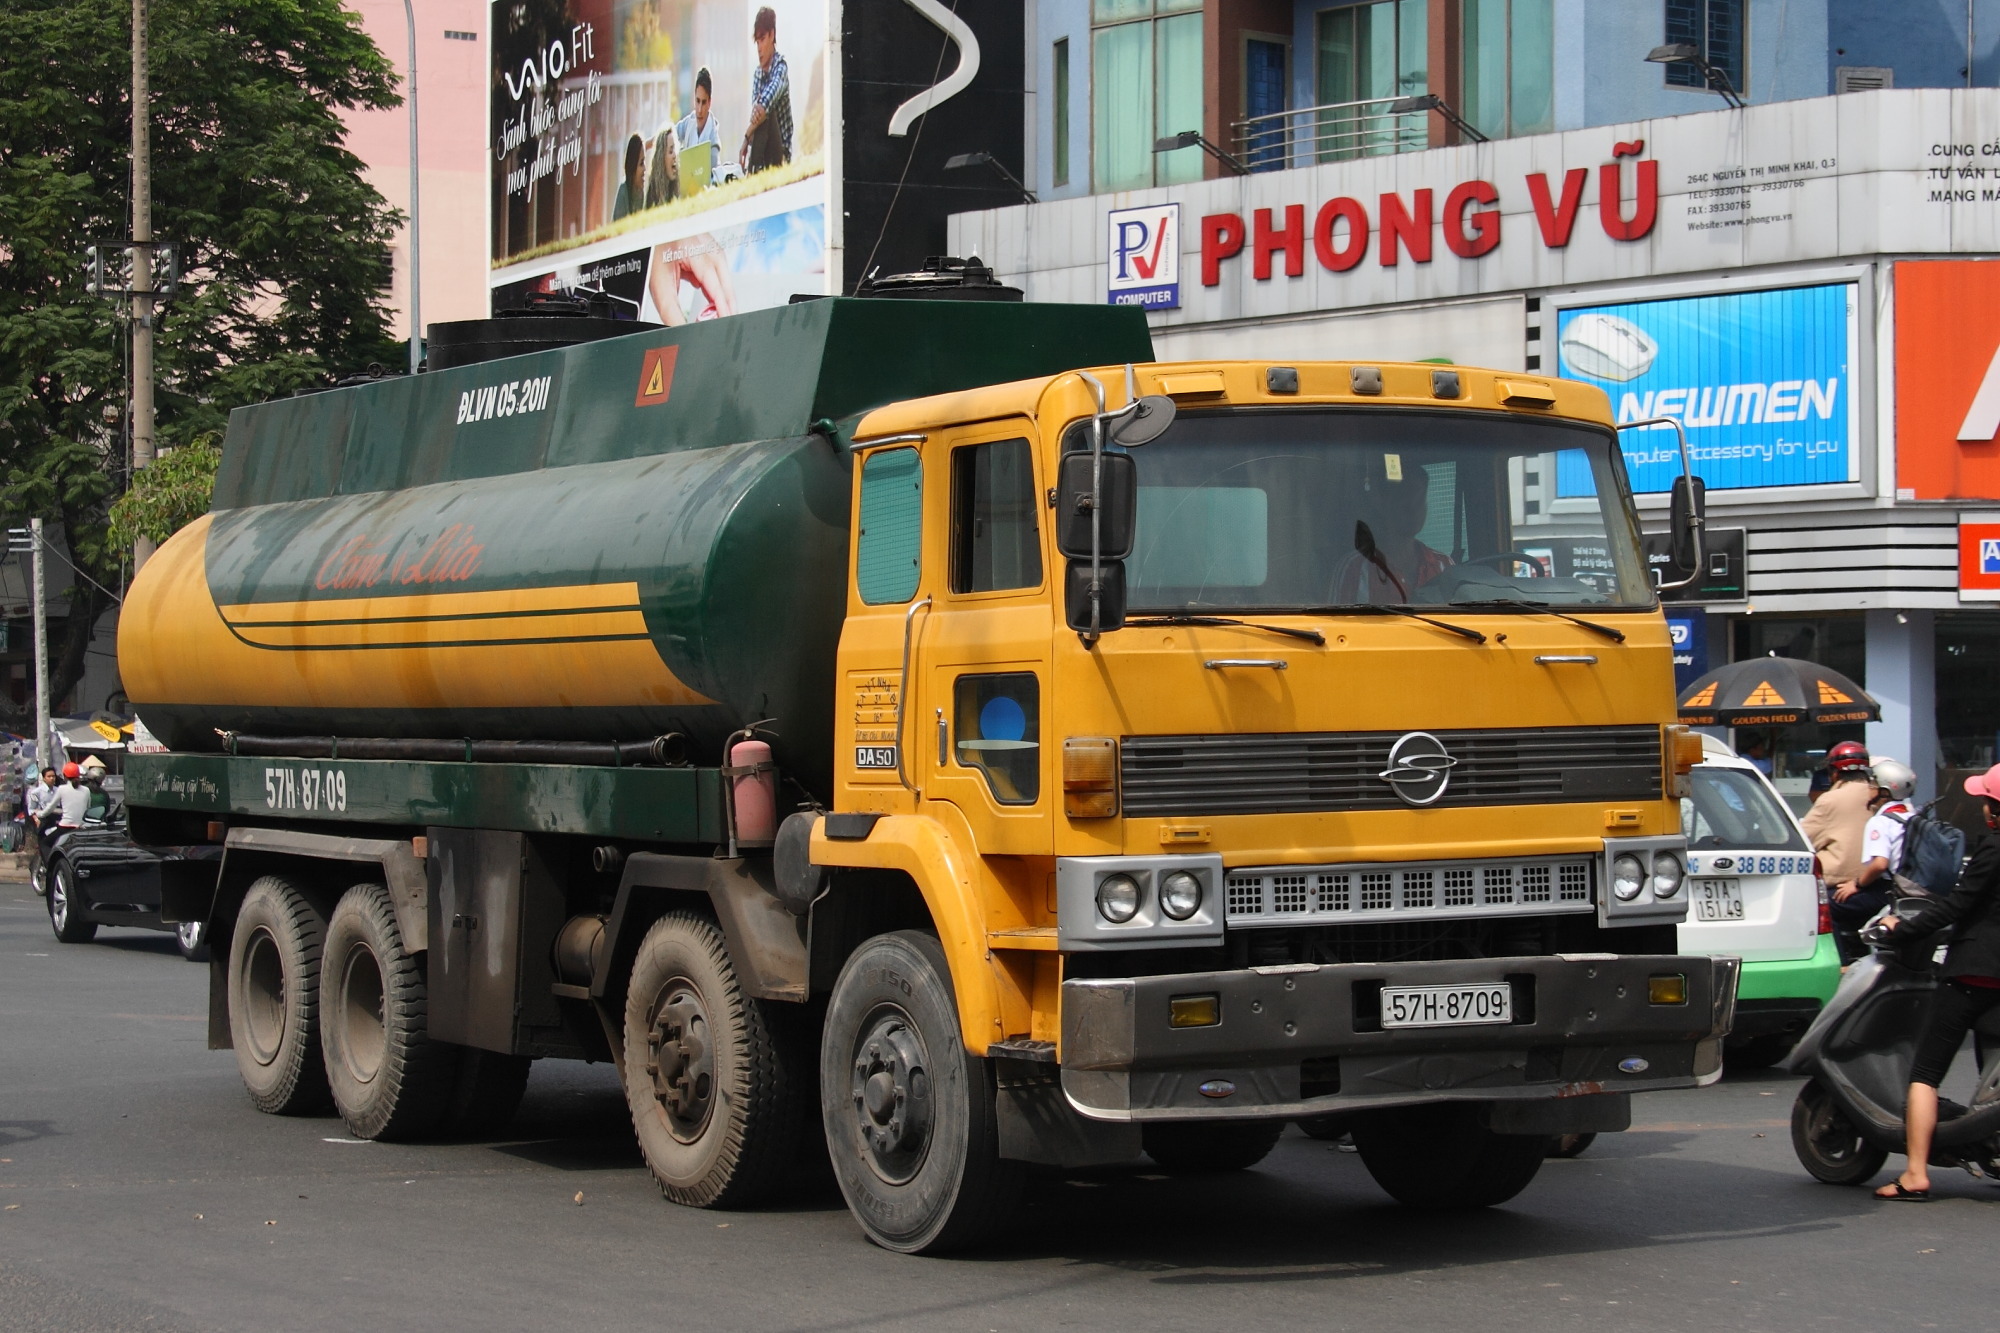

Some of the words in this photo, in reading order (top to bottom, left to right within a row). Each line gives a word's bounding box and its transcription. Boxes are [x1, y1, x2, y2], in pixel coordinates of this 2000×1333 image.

[505, 40, 565, 101] VAIO
[572, 22, 595, 69] Fit
[497, 103, 527, 160] Sánh
[558, 88, 585, 129] cùng
[587, 69, 602, 107] tôi
[507, 158, 528, 197] mọi
[527, 137, 556, 203] phút
[556, 131, 582, 185] giây
[1687, 173, 1709, 184] 264C
[1750, 167, 1764, 178] THỊ
[1768, 164, 1790, 175] MINH
[1794, 160, 1818, 172] KHAI,
[1821, 158, 1836, 168] Q.3
[1956, 161, 1985, 179] VẤN
[1200, 180, 1501, 287] PHONG
[1525, 139, 1659, 249] VŨ
[1116, 290, 1172, 304] COMPUTER
[1617, 378, 1838, 433] NEWMEN
[1623, 446, 1680, 468] mputer
[1776, 438, 1803, 456] for
[1806, 440, 1838, 459] you
[1648, 553, 1671, 563] Series
[1678, 716, 1698, 724] OLDEN
[1731, 716, 1770, 725] GOLDEN
[1771, 714, 1797, 723] FIELD
[1816, 714, 1846, 723] GOLDEN
[1847, 711, 1869, 721] FIELD
[1737, 857, 1755, 873] 38
[1758, 856, 1775, 873] 68
[1779, 857, 1794, 873] 68
[1797, 857, 1811, 873] 68
[1703, 881, 1730, 899] 51A
[1699, 900, 1742, 918] 151.49
